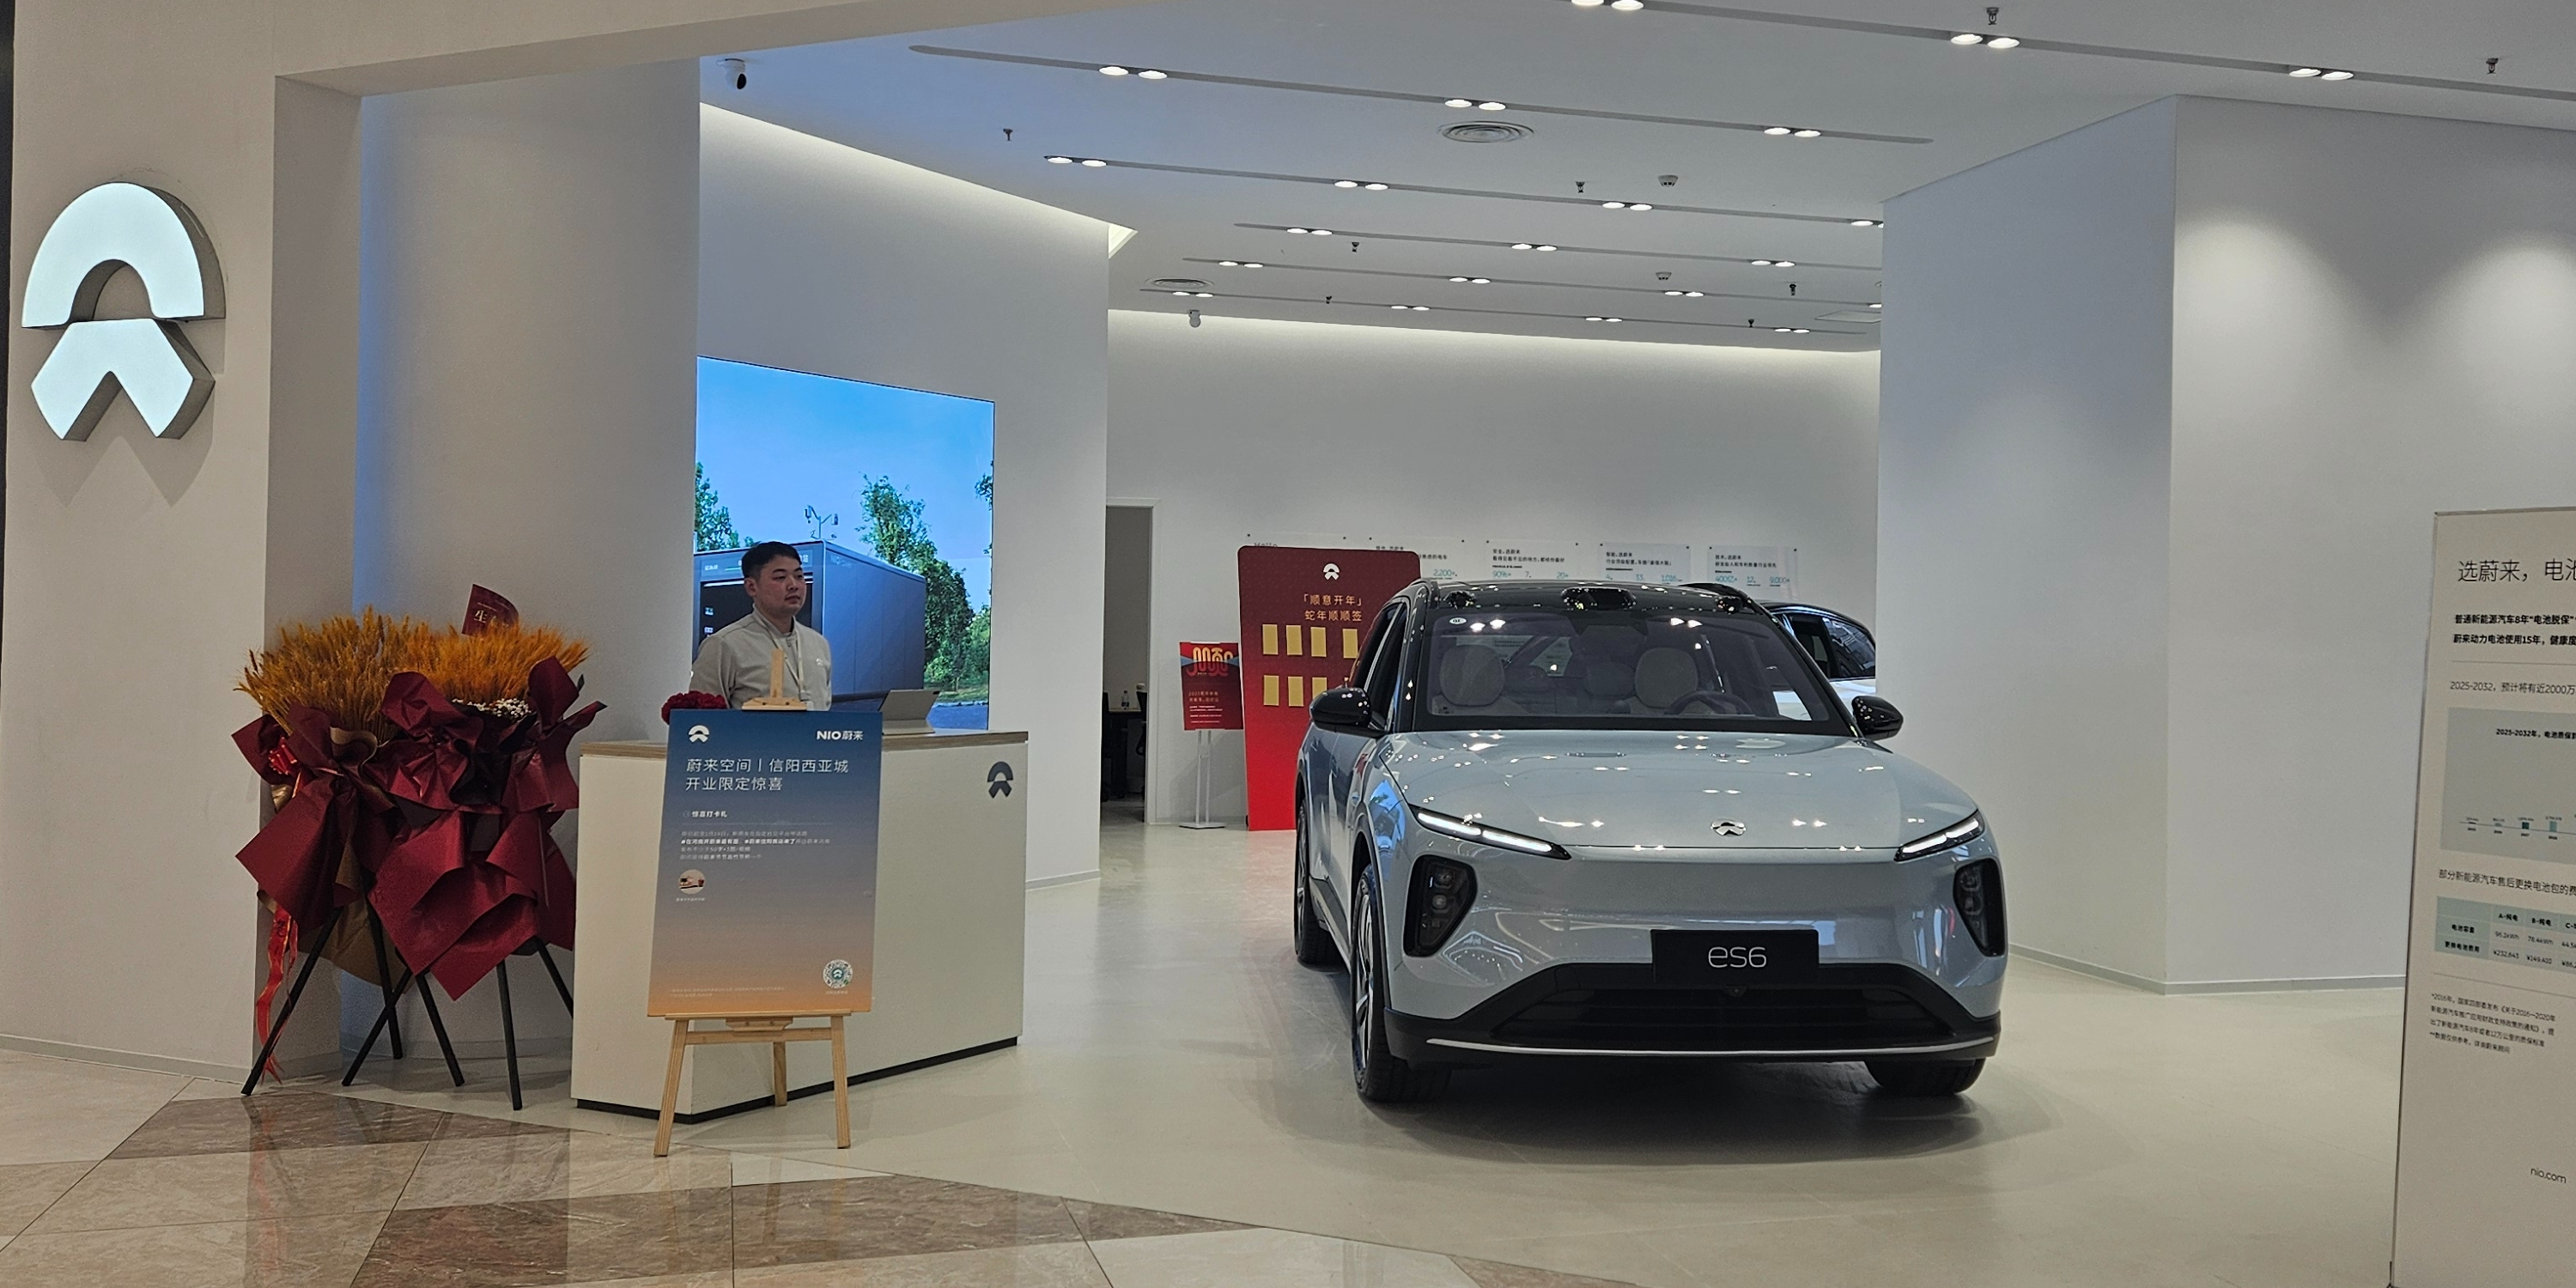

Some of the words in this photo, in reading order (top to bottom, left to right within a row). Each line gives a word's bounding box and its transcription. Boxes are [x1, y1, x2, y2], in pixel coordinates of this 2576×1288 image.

[1303, 593, 1363, 606] 「顺意开年」
[1304, 610, 1363, 622] 蛇年顺顺签
[685, 776, 783, 791] 开业限定惊喜
[2531, 1168, 2567, 1184] nio.com
